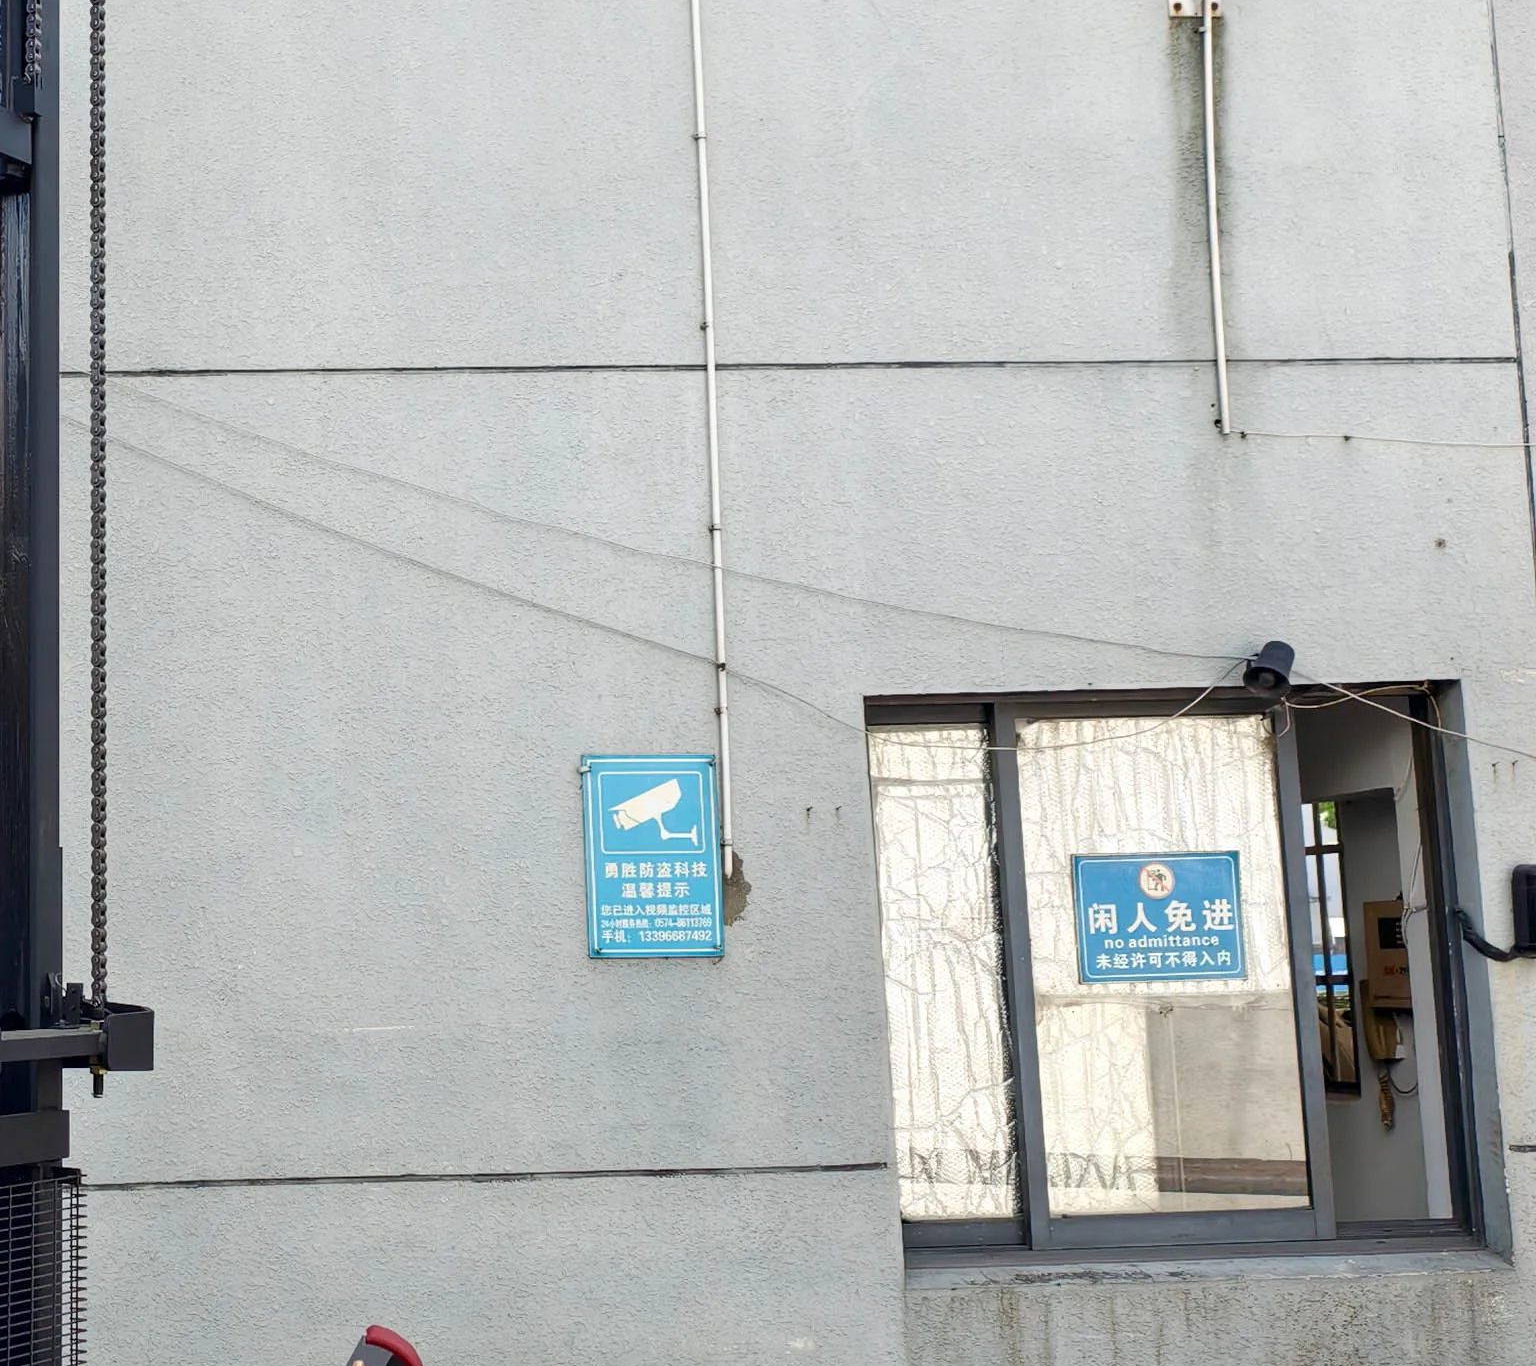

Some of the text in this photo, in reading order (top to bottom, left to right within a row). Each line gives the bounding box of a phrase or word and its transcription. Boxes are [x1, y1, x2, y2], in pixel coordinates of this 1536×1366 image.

[604, 862, 708, 878] 勇胜防盗科技
[621, 882, 690, 898] 温馨提示
[600, 904, 713, 916] 您已进入视频监控区域
[1088, 898, 1235, 935] 闲人免进
[1104, 935, 1220, 950] no admittance
[1095, 950, 1232, 970] 未经许可不得入内
